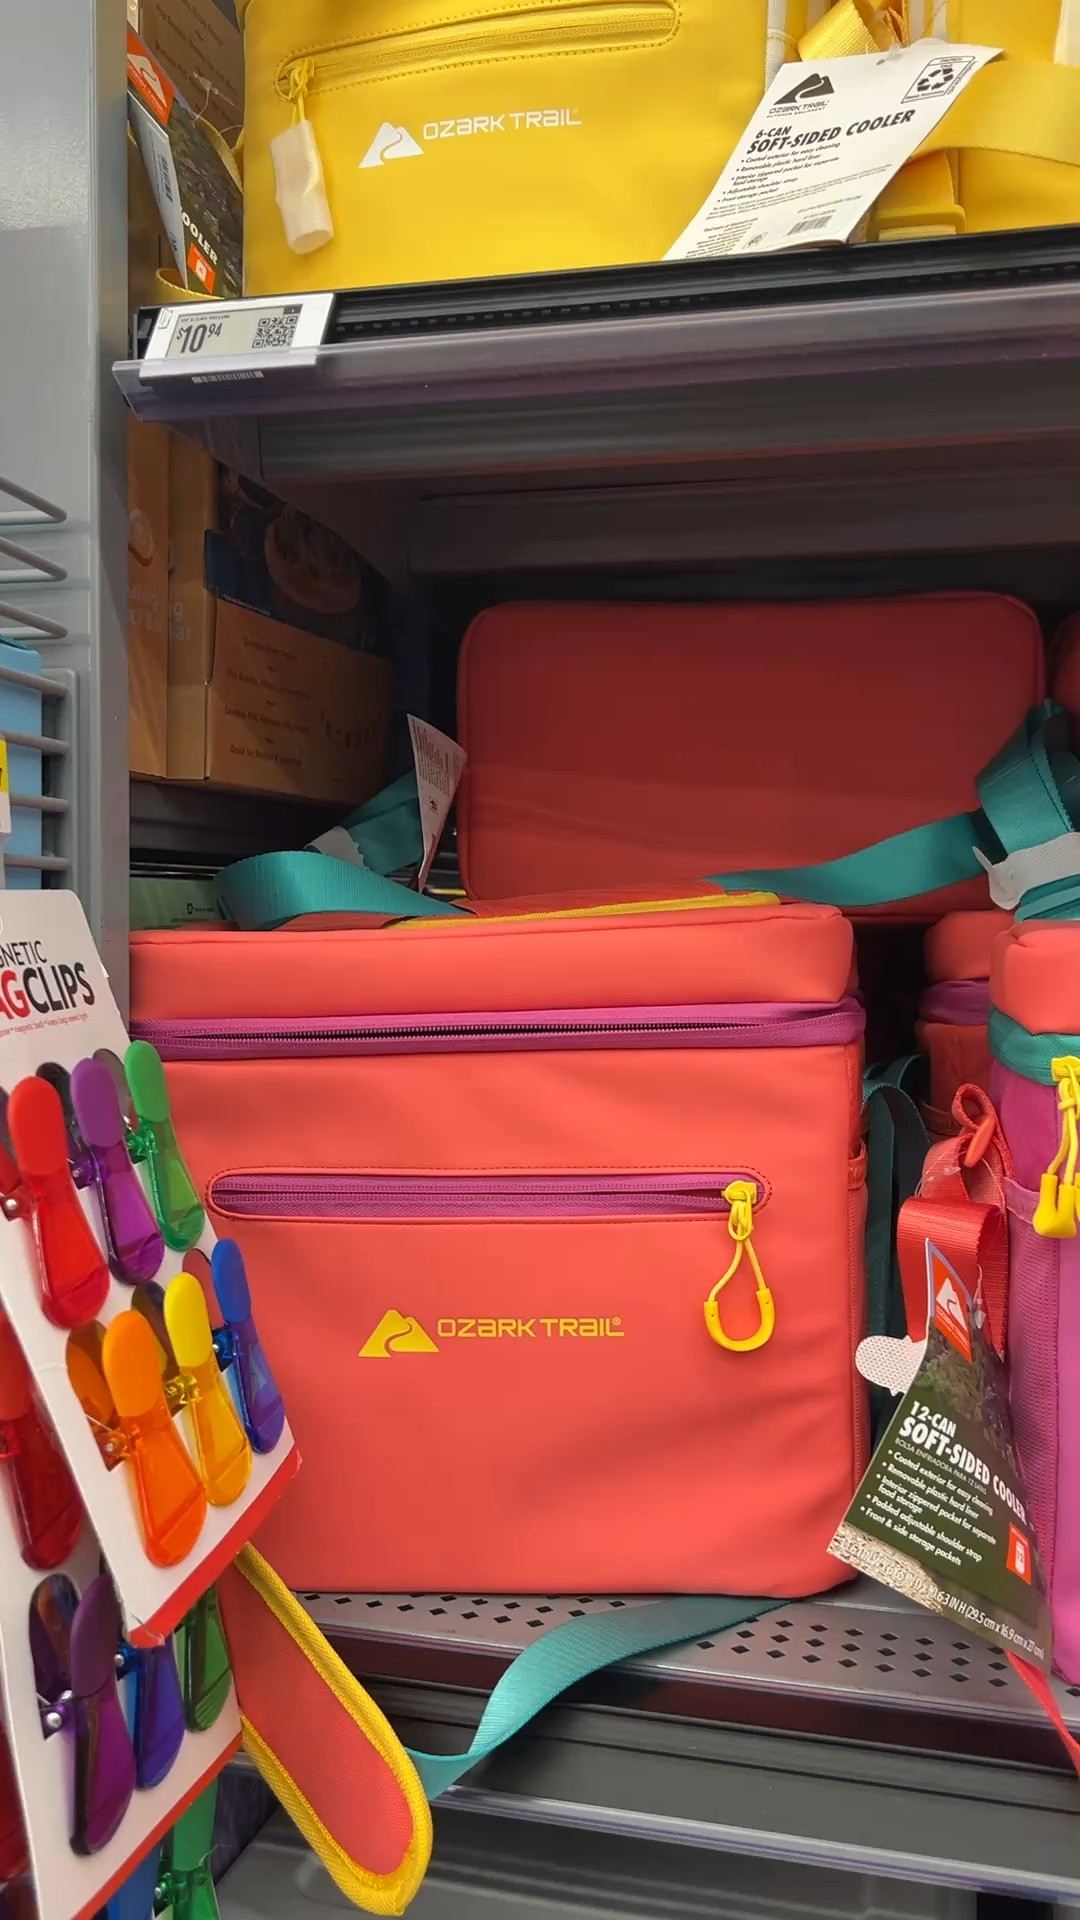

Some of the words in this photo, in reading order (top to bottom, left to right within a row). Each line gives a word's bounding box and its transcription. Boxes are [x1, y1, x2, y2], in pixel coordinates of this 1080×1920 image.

[423, 114, 505, 140] OZARK
[746, 126, 842, 155] SOFT-SIDED
[846, 109, 916, 136] COOLER
[755, 126, 792, 139] 6-CAN
[181, 211, 219, 265] OOLER
[0, 940, 47, 968] NETIC
[437, 1318, 536, 1338] OZARK
[910, 1400, 957, 1438] 12-CAN
[887, 1463, 926, 1490] Removable
[925, 1485, 949, 1503] plastic
[948, 1496, 966, 1511] hard
[965, 1504, 980, 1519] liner
[893, 1452, 920, 1471] Coated
[919, 1467, 947, 1485] exterior
[946, 1479, 957, 1491] for
[956, 1487, 972, 1501] easy
[971, 1495, 994, 1517] cleaning
[899, 1416, 991, 1485] SOFT-SIDED
[993, 1475, 1028, 1525] COOLER
[878, 1483, 897, 1499] food
[896, 1495, 923, 1514] storage
[881, 1475, 908, 1495] Interior
[907, 1491, 941, 1513] zippered
[938, 1508, 962, 1525] pocket
[961, 1518, 972, 1530] for
[971, 1526, 997, 1545] separate
[865, 1507, 886, 1524] Front
[885, 1519, 893, 1529] &
[893, 1524, 909, 1536] side
[908, 1533, 936, 1551] storage
[935, 1547, 962, 1566] pockets
[871, 1495, 901, 1517] Padded
[899, 1512, 937, 1536] adjustable
[936, 1532, 966, 1552] shoulder
[965, 1548, 983, 1562] strap
[948, 1595, 958, 1610] IN
[957, 1600, 967, 1614] H
